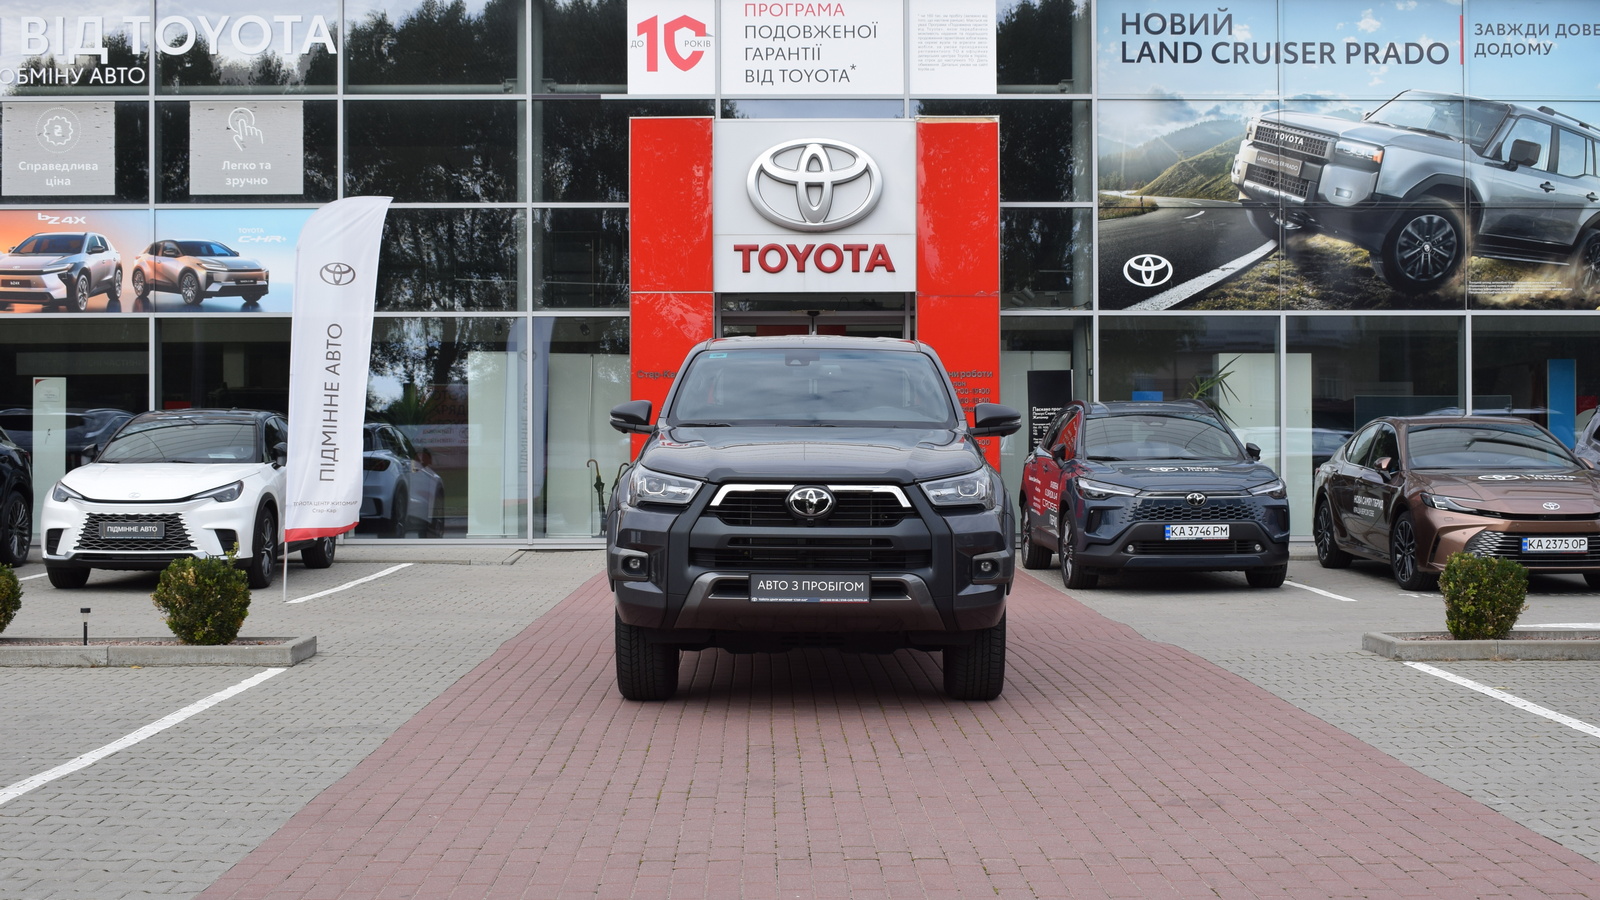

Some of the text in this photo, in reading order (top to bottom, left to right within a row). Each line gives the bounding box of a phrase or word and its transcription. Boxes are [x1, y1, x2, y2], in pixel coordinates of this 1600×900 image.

[744, 2, 846, 18] ПРОГРАМА
[1121, 7, 1233, 36] НОВИЙ
[744, 21, 879, 42] ПОДОВЖЕНОЇ
[1473, 22, 1551, 39] ЗАВЖДИ
[20, 14, 338, 65] ВІД TOYOTA
[630, 39, 645, 49] ДО
[683, 39, 712, 48] РОКІВ
[744, 43, 823, 62] ГАРАНТІЇ
[1121, 41, 1450, 66] LAND CRUISER PRADO
[1474, 41, 1554, 59] ДОДОМУ
[0, 65, 146, 86] ОБМІНУ АВТО
[744, 67, 775, 86] ВІД
[1275, 132, 1304, 145] TOYOTA
[18, 159, 99, 174] Справедлива
[221, 159, 272, 172] Легко та
[45, 176, 72, 188] ціна
[225, 175, 269, 188] зручно
[733, 242, 897, 275] TOYOTA
[637, 369, 678, 381] Стар-Ка
[960, 369, 993, 379] роботи
[319, 322, 343, 482] ПІДМІННЕ АВТО
[107, 525, 158, 533] ПІДМІННЕ АВТО
[1171, 526, 1228, 536] KA 3746 PM
[1528, 539, 1587, 550] KA 2375 OP
[757, 580, 864, 592] АВТО З ПРОБІГОМ
